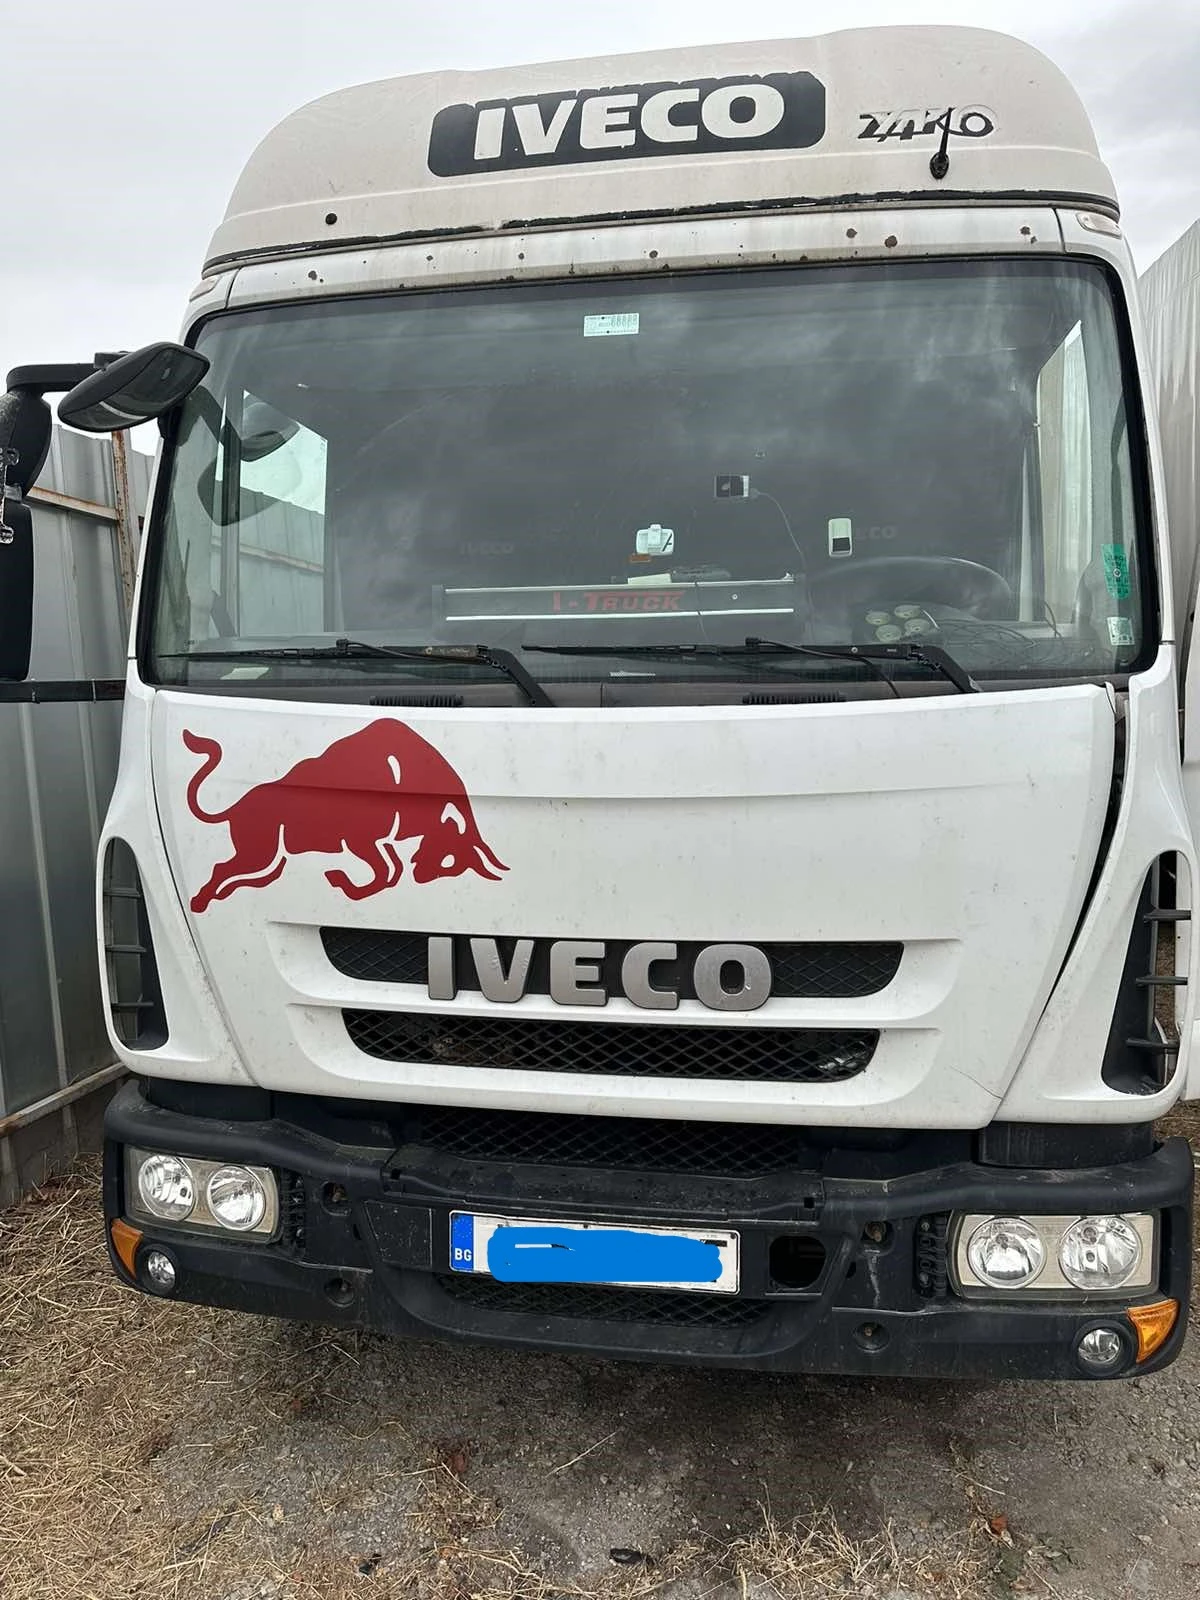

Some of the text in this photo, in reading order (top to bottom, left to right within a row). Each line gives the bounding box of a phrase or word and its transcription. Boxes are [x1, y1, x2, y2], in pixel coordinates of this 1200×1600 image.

[474, 82, 785, 161] IVECO
[427, 936, 773, 1012] IVECO
[454, 1247, 472, 1262] BG
